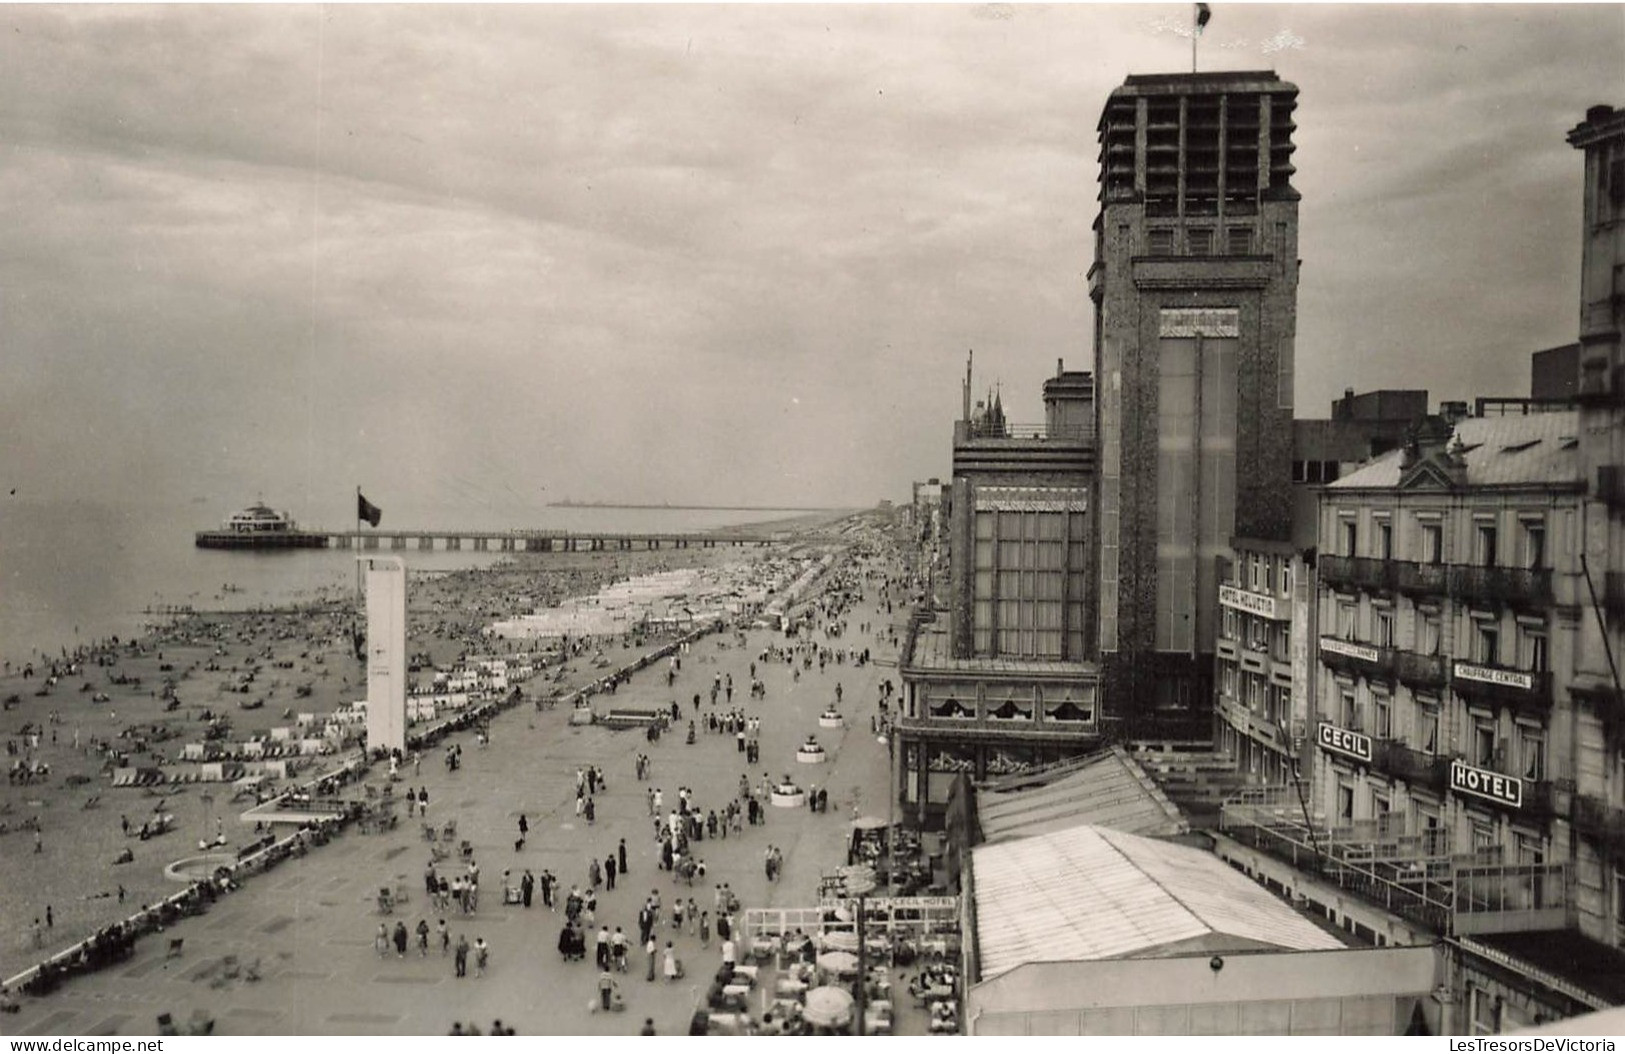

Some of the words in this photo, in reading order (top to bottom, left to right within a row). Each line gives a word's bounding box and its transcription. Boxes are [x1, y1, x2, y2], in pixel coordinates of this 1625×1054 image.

[1221, 588, 1239, 604] HOTEL
[1458, 664, 1494, 681] CHAUFFAGE
[1495, 671, 1527, 686] CENTRAL
[1322, 727, 1367, 756] CECIL
[1456, 766, 1516, 800] HOTEL
[893, 897, 919, 906] CECIL
[923, 897, 954, 906] HOTEL
